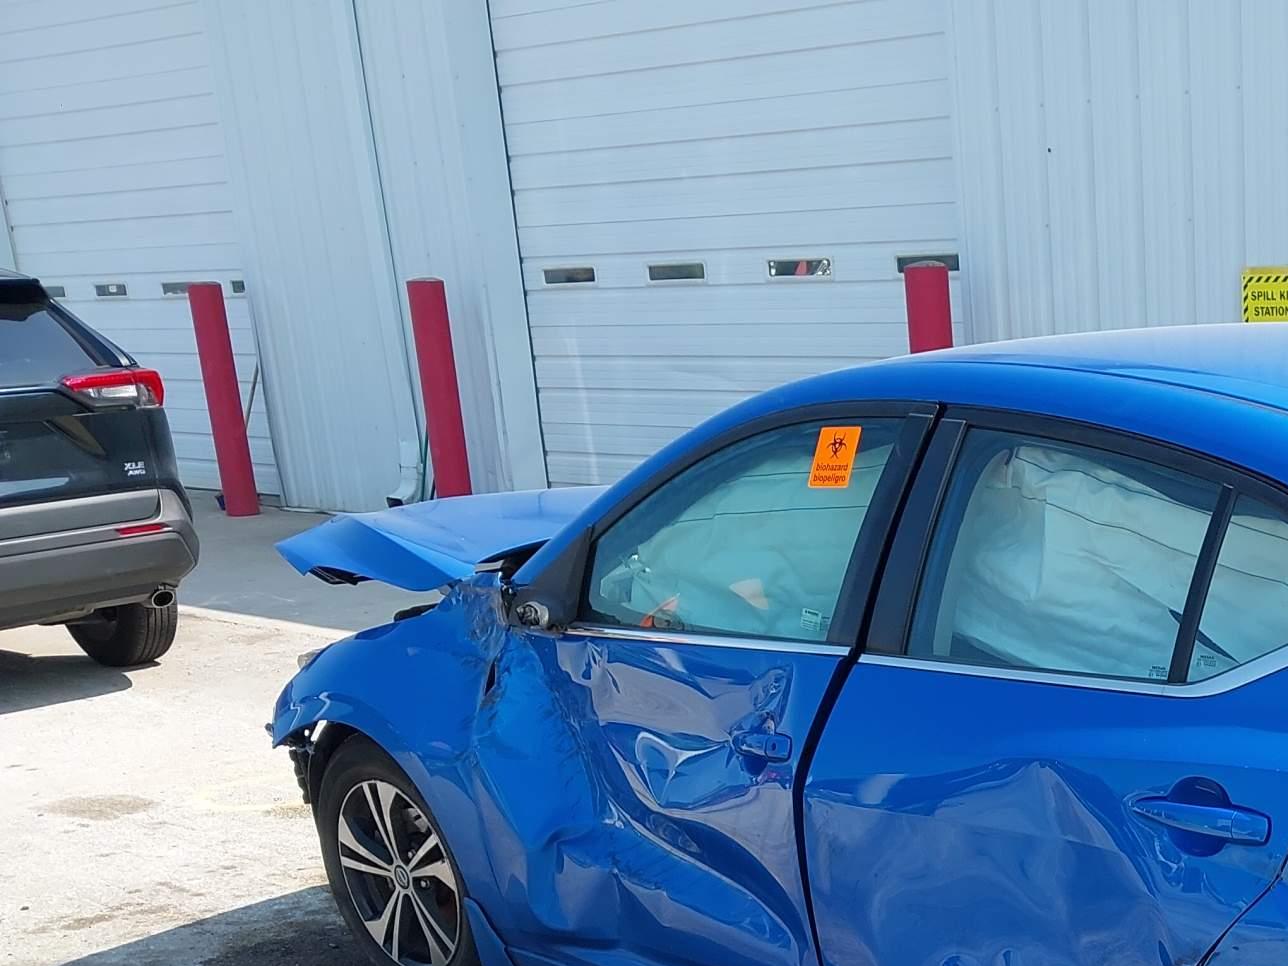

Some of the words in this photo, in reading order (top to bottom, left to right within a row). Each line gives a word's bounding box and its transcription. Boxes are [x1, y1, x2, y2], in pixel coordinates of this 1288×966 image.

[1251, 290, 1276, 301] SPILL
[124, 461, 145, 470] XLE
[816, 463, 849, 471] biohazard
[813, 473, 846, 484] biopeligro
